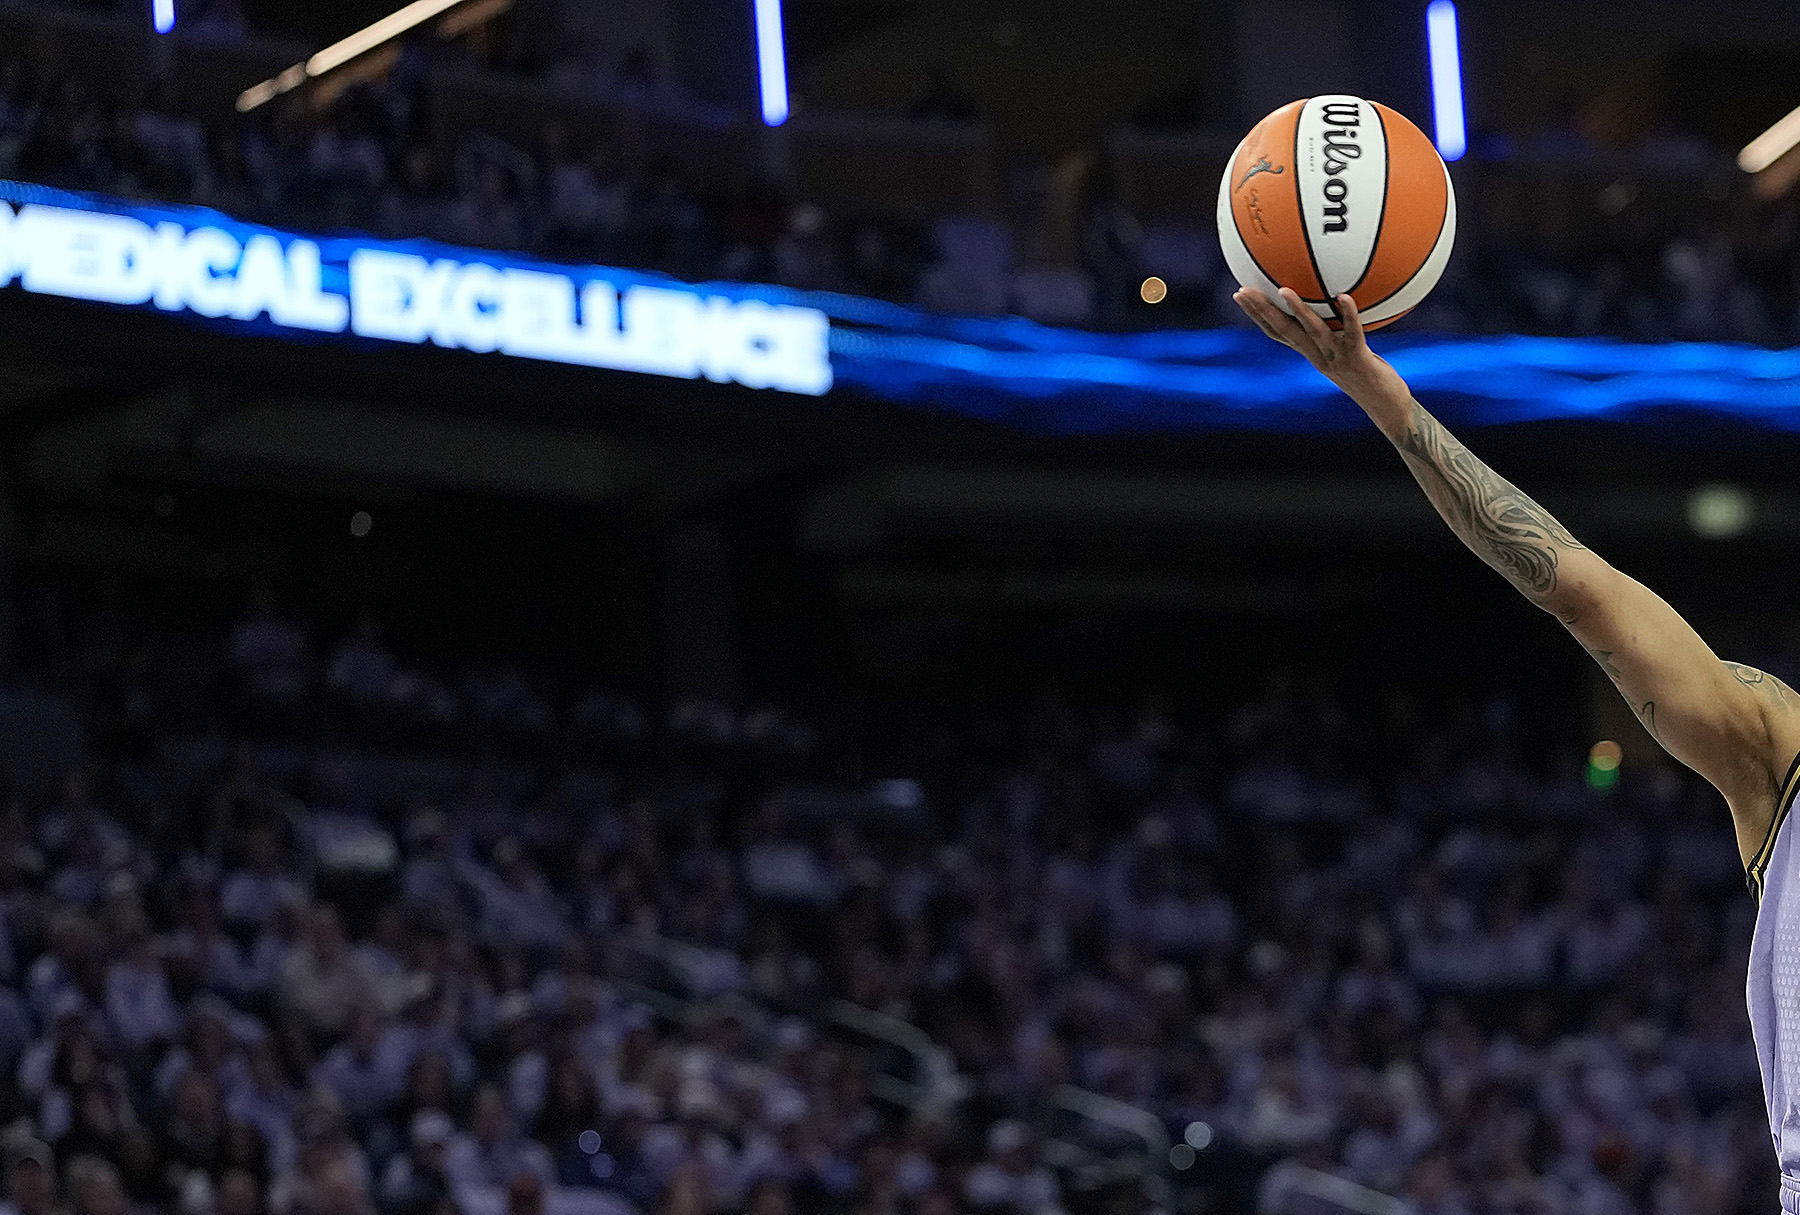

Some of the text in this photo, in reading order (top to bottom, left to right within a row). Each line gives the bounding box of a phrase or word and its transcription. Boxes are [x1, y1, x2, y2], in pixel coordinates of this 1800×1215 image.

[1322, 103, 1361, 235] Wilson
[0, 202, 834, 397] MEDICAL EXCELLENCE
